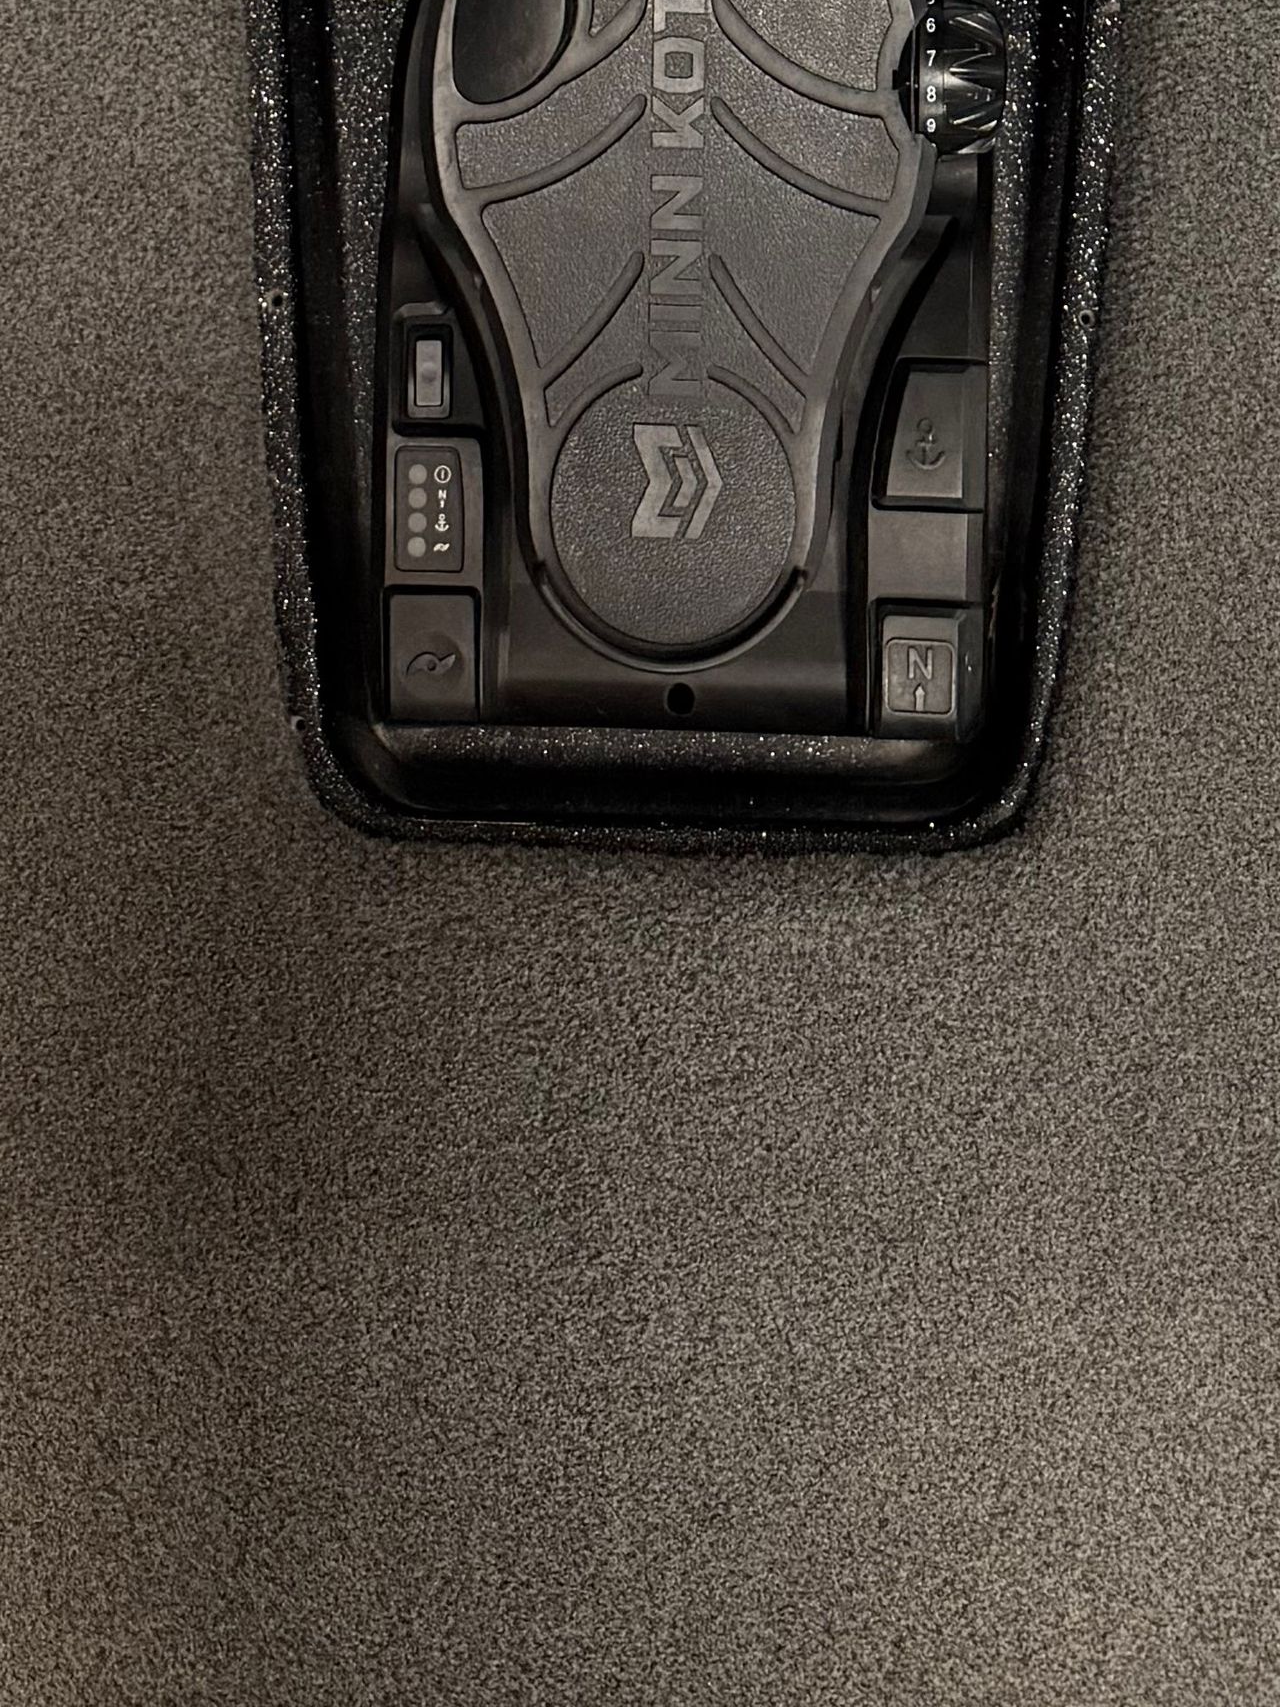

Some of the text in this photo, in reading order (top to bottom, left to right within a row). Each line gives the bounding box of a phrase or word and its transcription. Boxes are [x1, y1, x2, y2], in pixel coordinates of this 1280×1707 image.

[926, 18, 936, 33] 6
[926, 50, 937, 67] 7
[926, 86, 937, 102] 8
[926, 118, 937, 133] 9
[647, 173, 705, 397] MINN
[908, 647, 933, 680] N
